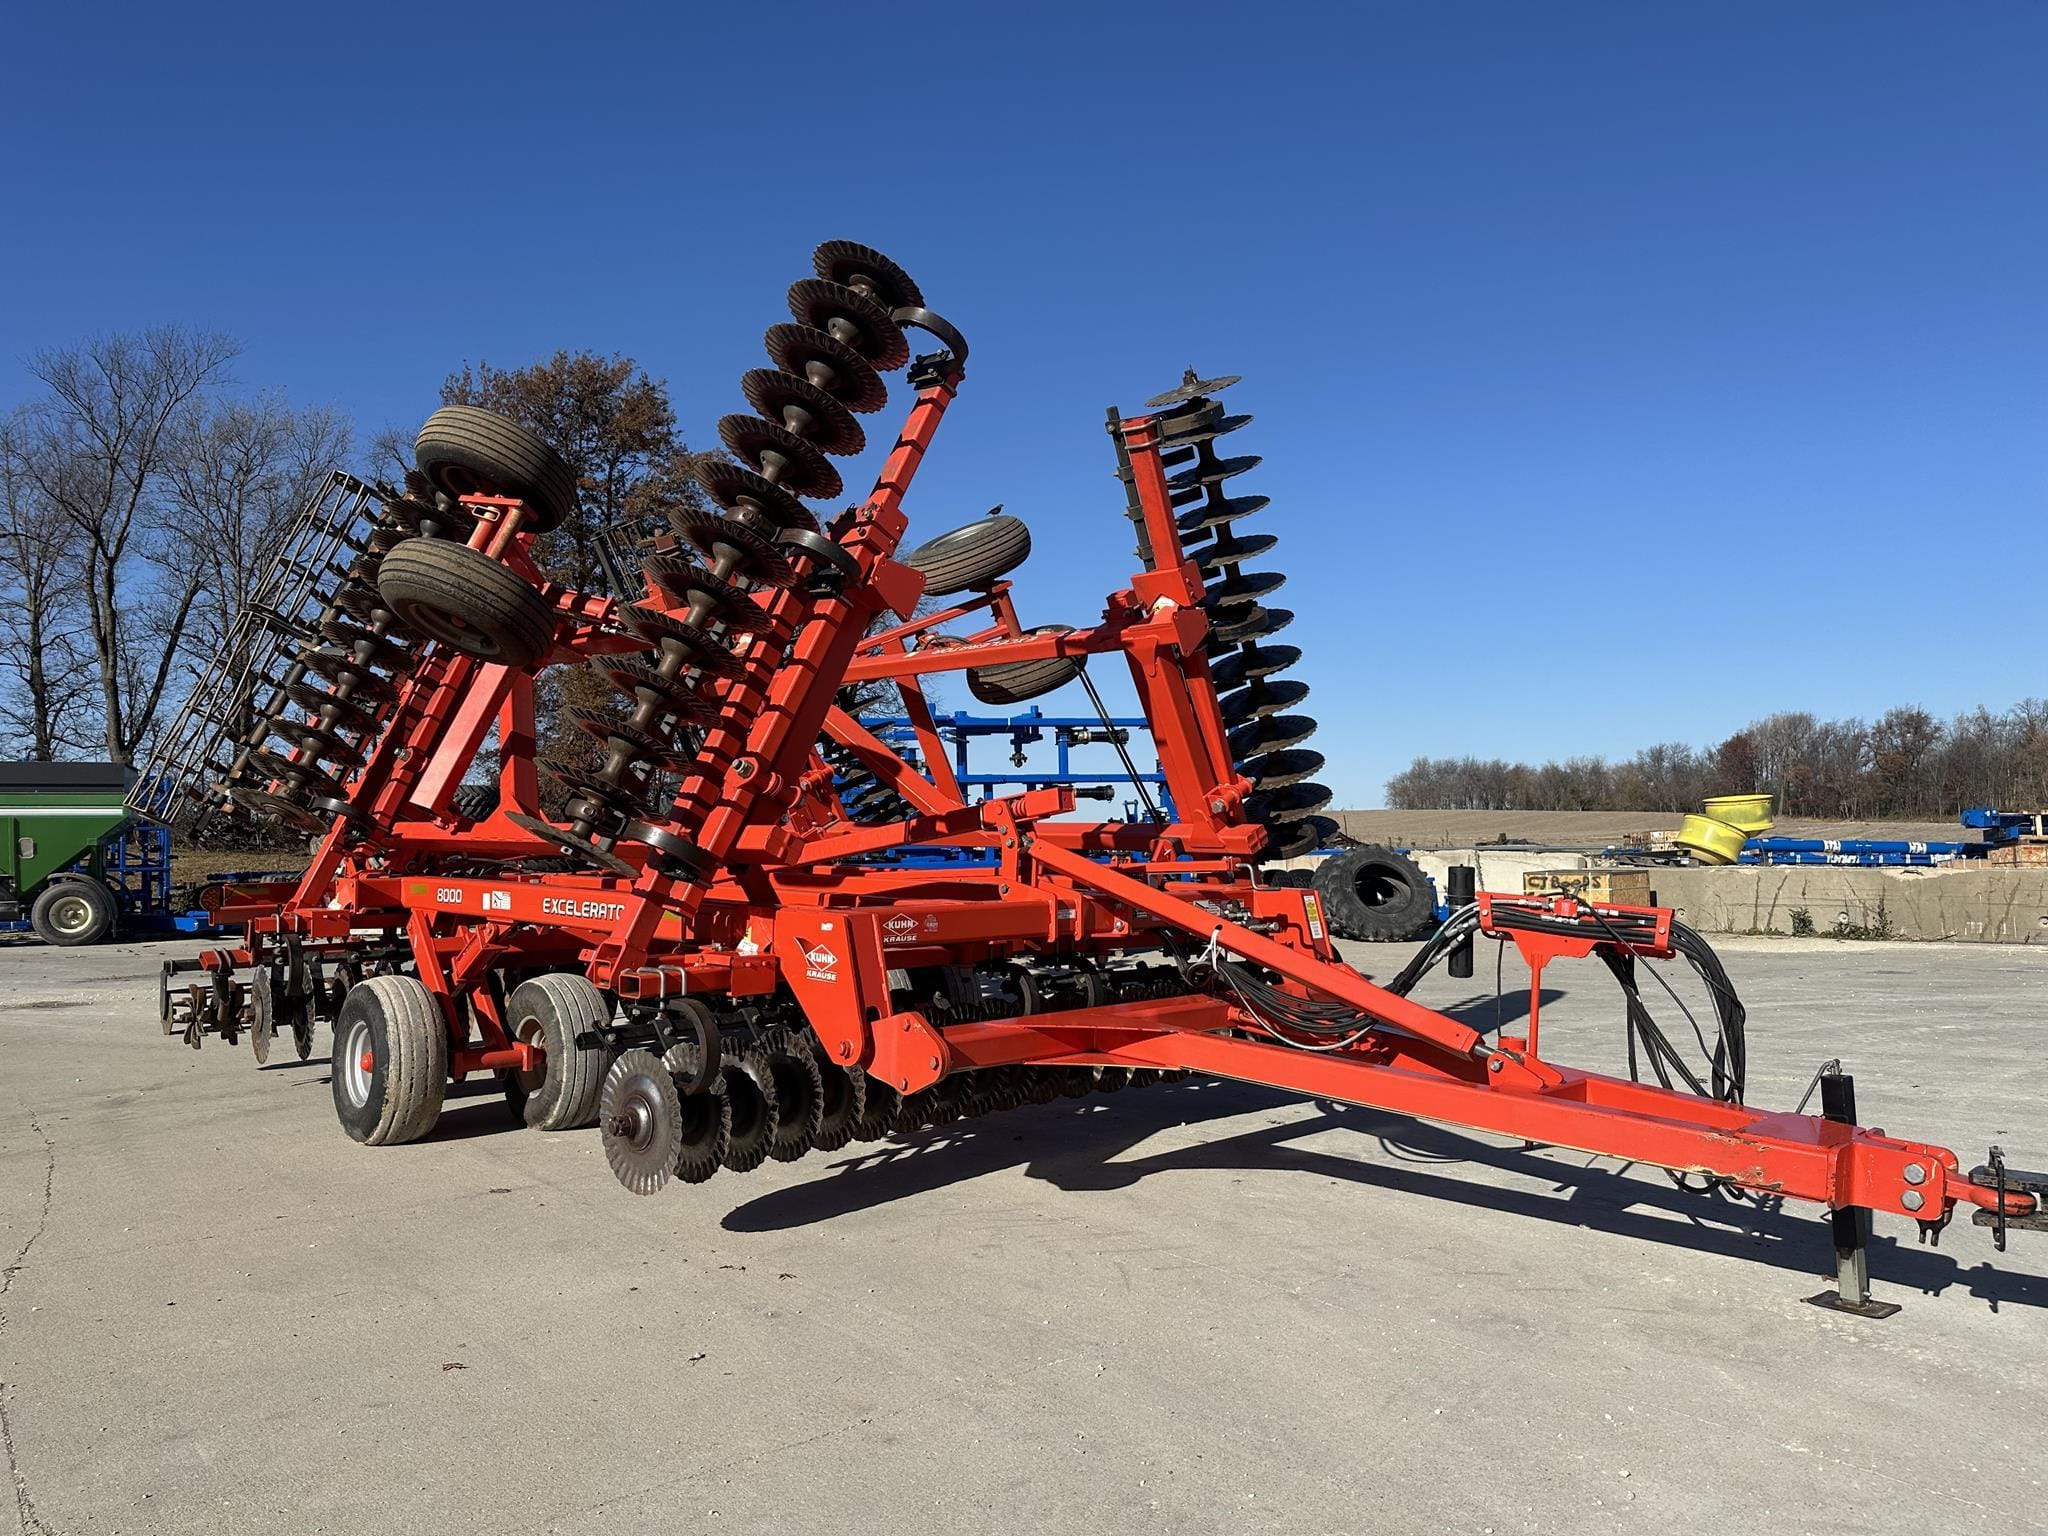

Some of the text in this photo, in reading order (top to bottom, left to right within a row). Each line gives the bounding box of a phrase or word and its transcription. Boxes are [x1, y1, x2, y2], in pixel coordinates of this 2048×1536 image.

[436, 888, 462, 903] 8000
[543, 897, 625, 921] EXCELERATO
[888, 919, 914, 930] KUHN
[883, 935, 917, 943] KRAUSE
[810, 952, 834, 964] KUHN
[806, 970, 837, 981] KRAUSE
